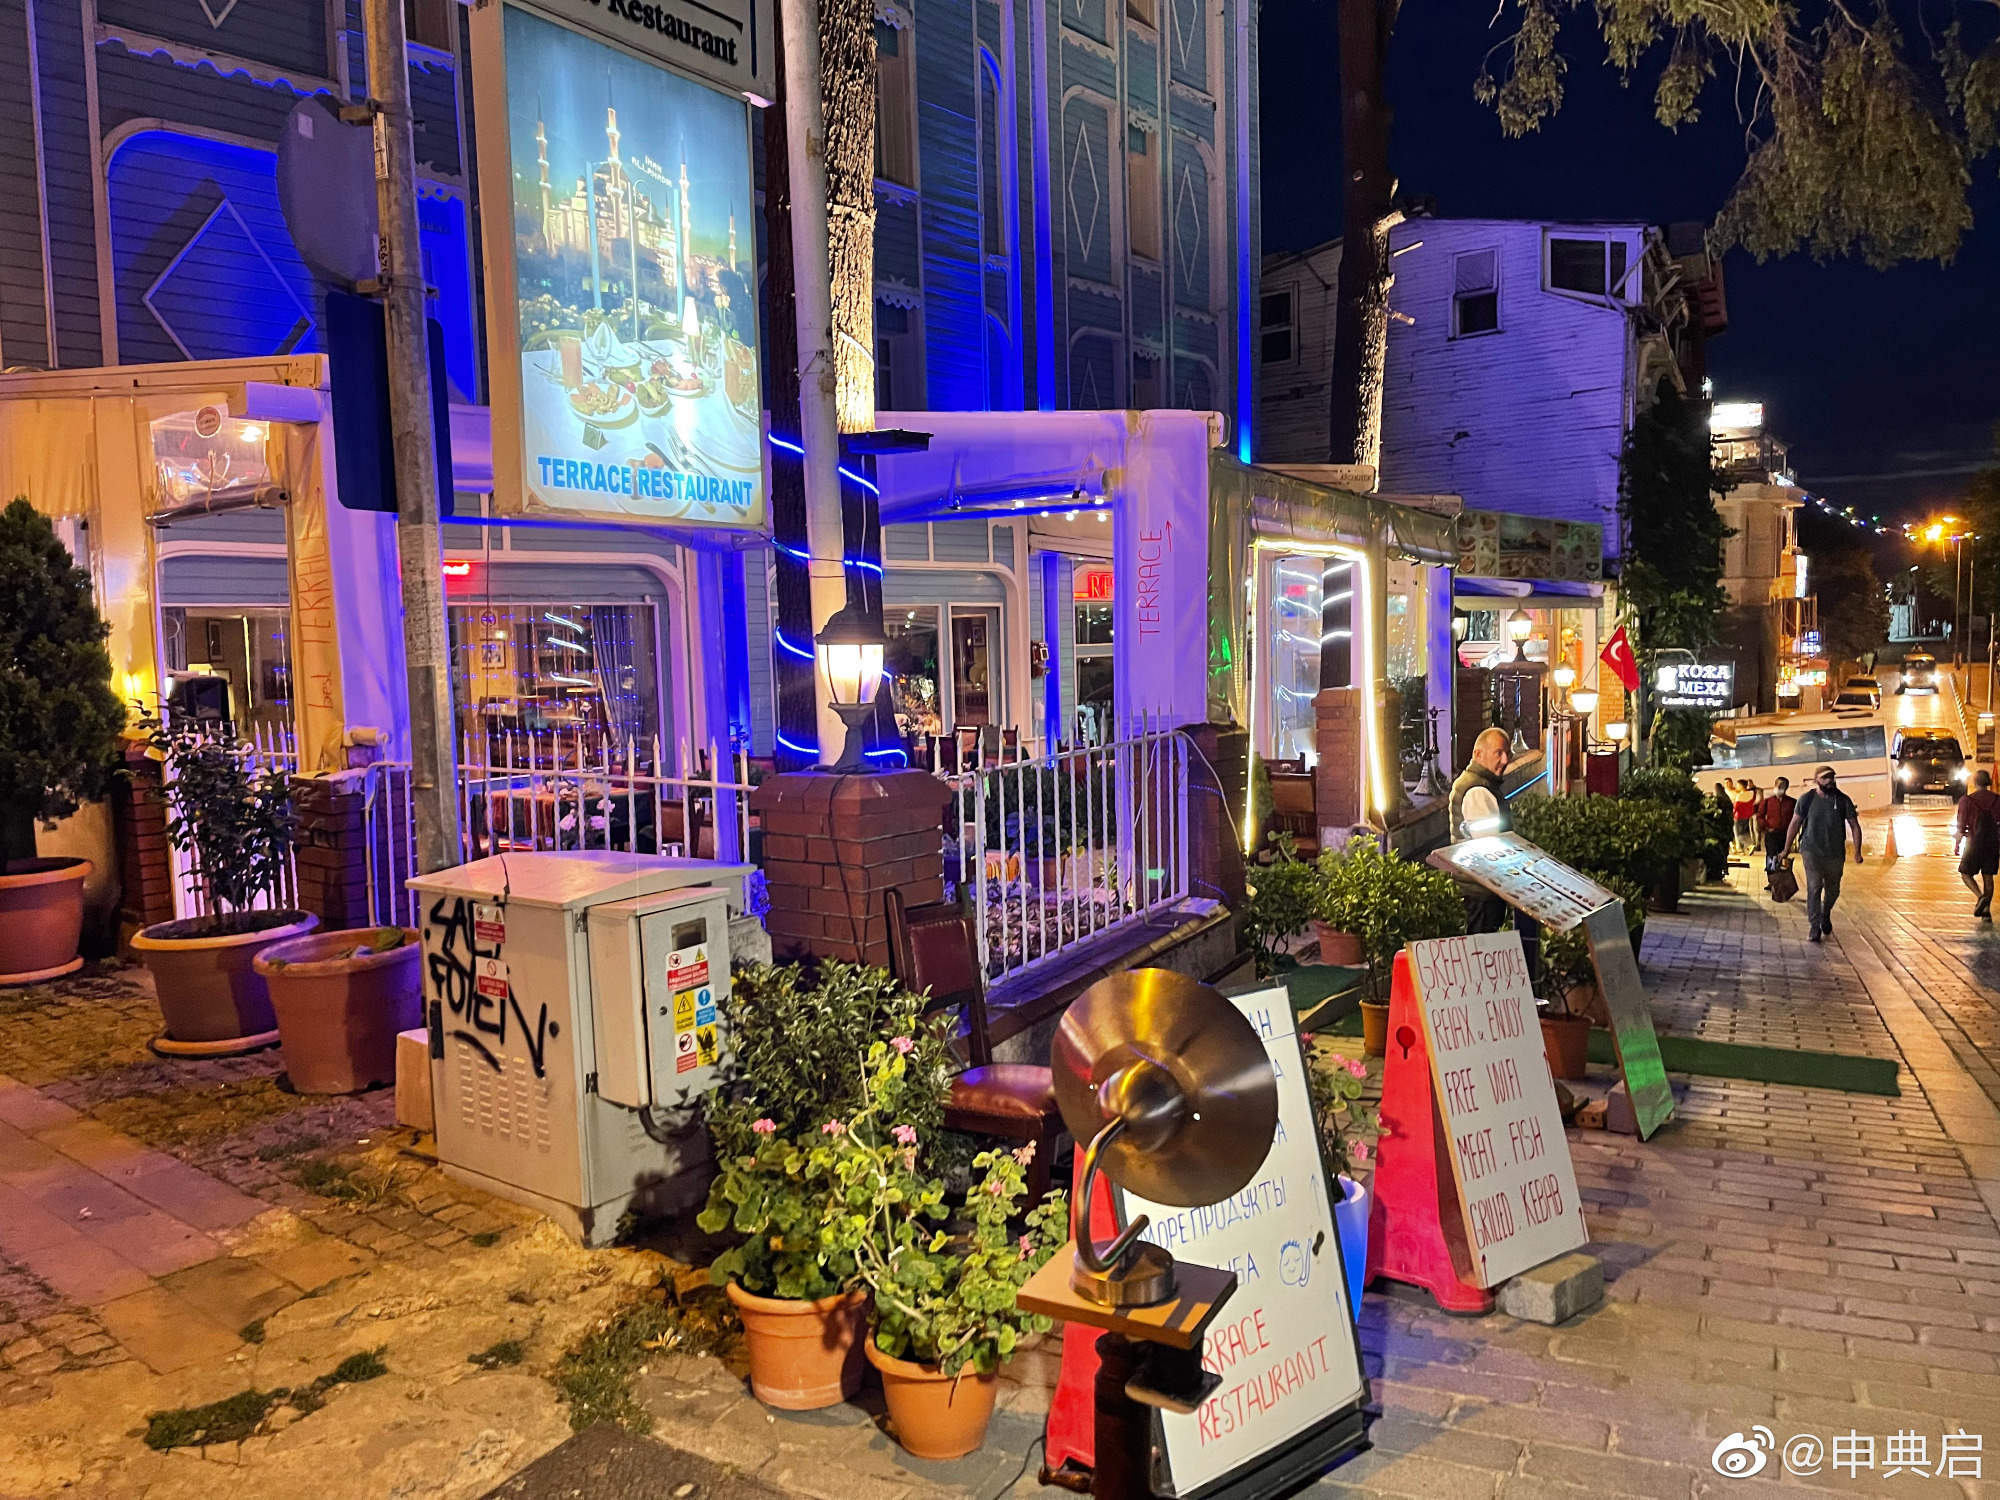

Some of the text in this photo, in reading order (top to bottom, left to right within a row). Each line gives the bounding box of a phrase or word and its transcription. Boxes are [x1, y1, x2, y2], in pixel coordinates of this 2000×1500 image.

[538, 456, 753, 506] TERRACE RESTAURANT
[1137, 529, 1163, 645] TERRACE
[1677, 664, 1731, 680] КОЖА
[1415, 936, 1472, 989] GREAT
[1485, 997, 1525, 1042] ENJOY
[1445, 1058, 1522, 1117] FREE WIFI
[1508, 1115, 1545, 1164] FISH
[1519, 1173, 1564, 1228] KEBAB
[1197, 1335, 1330, 1447] RESTAURANT
